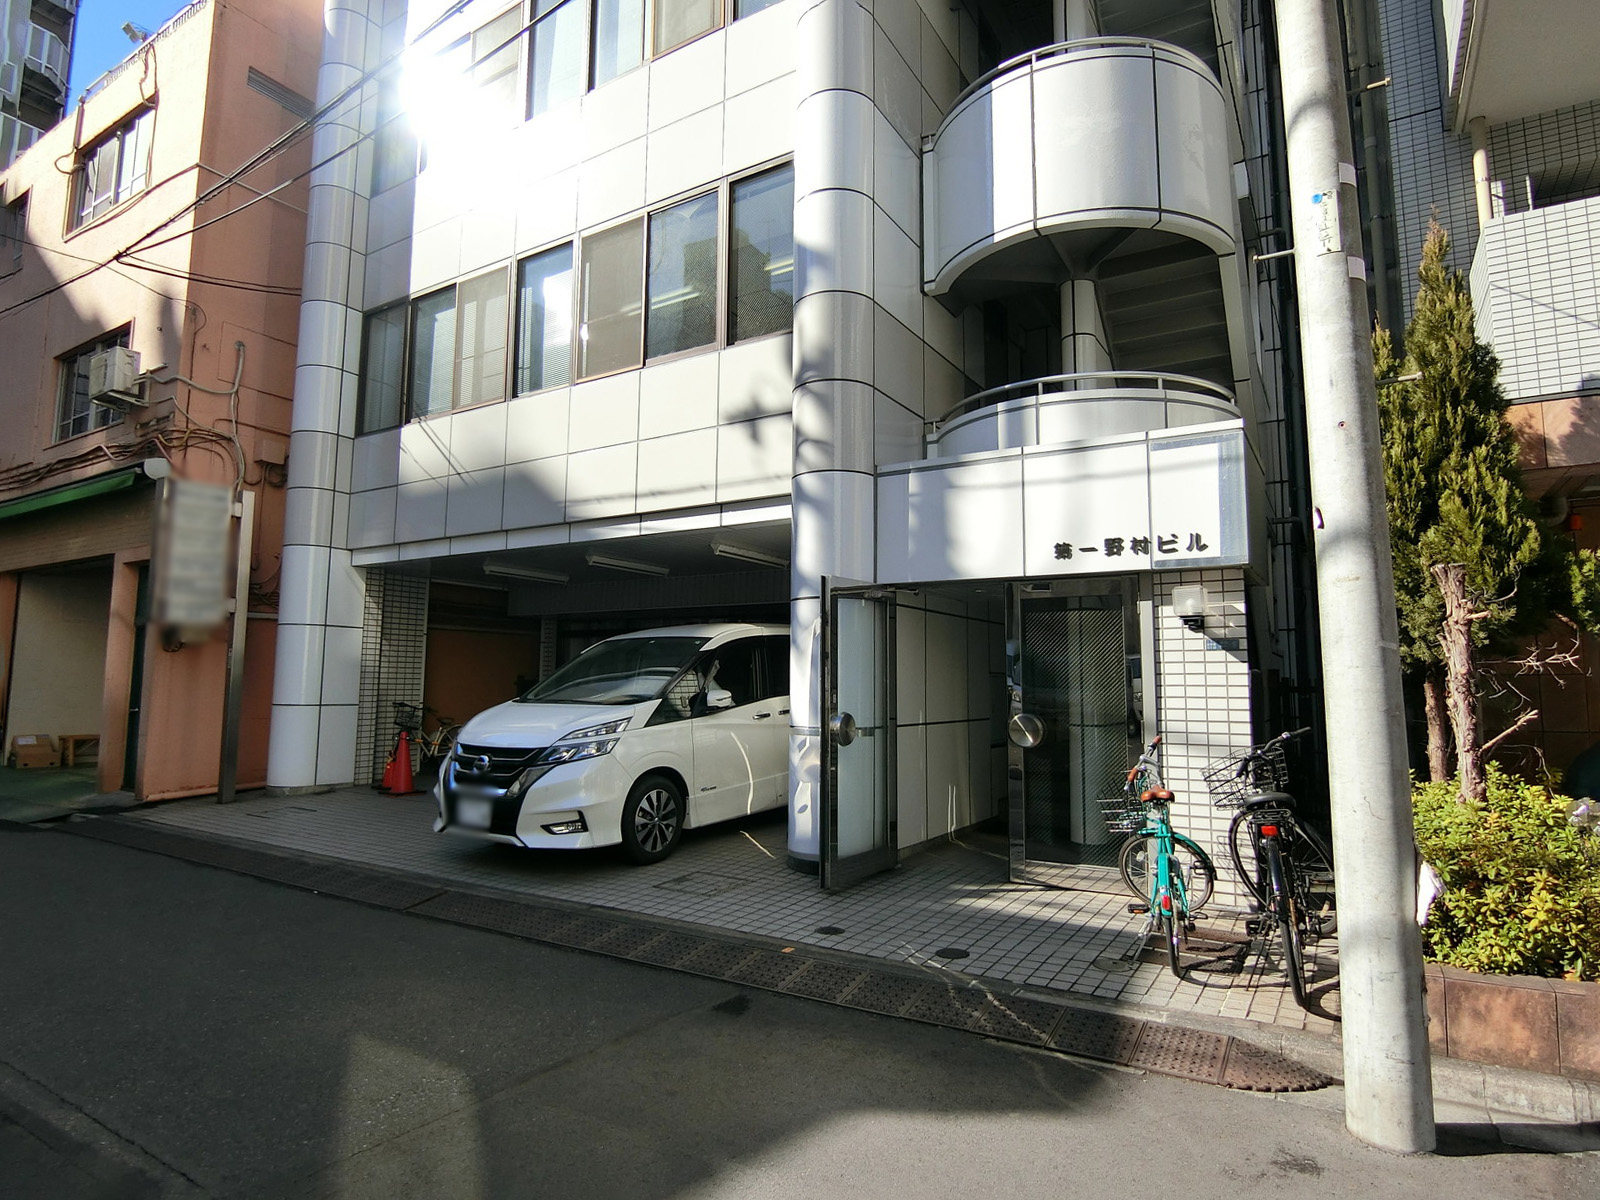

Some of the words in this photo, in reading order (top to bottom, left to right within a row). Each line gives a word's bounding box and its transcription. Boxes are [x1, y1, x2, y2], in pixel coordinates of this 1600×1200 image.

[1054, 533, 1209, 560] 第一野村ビル
